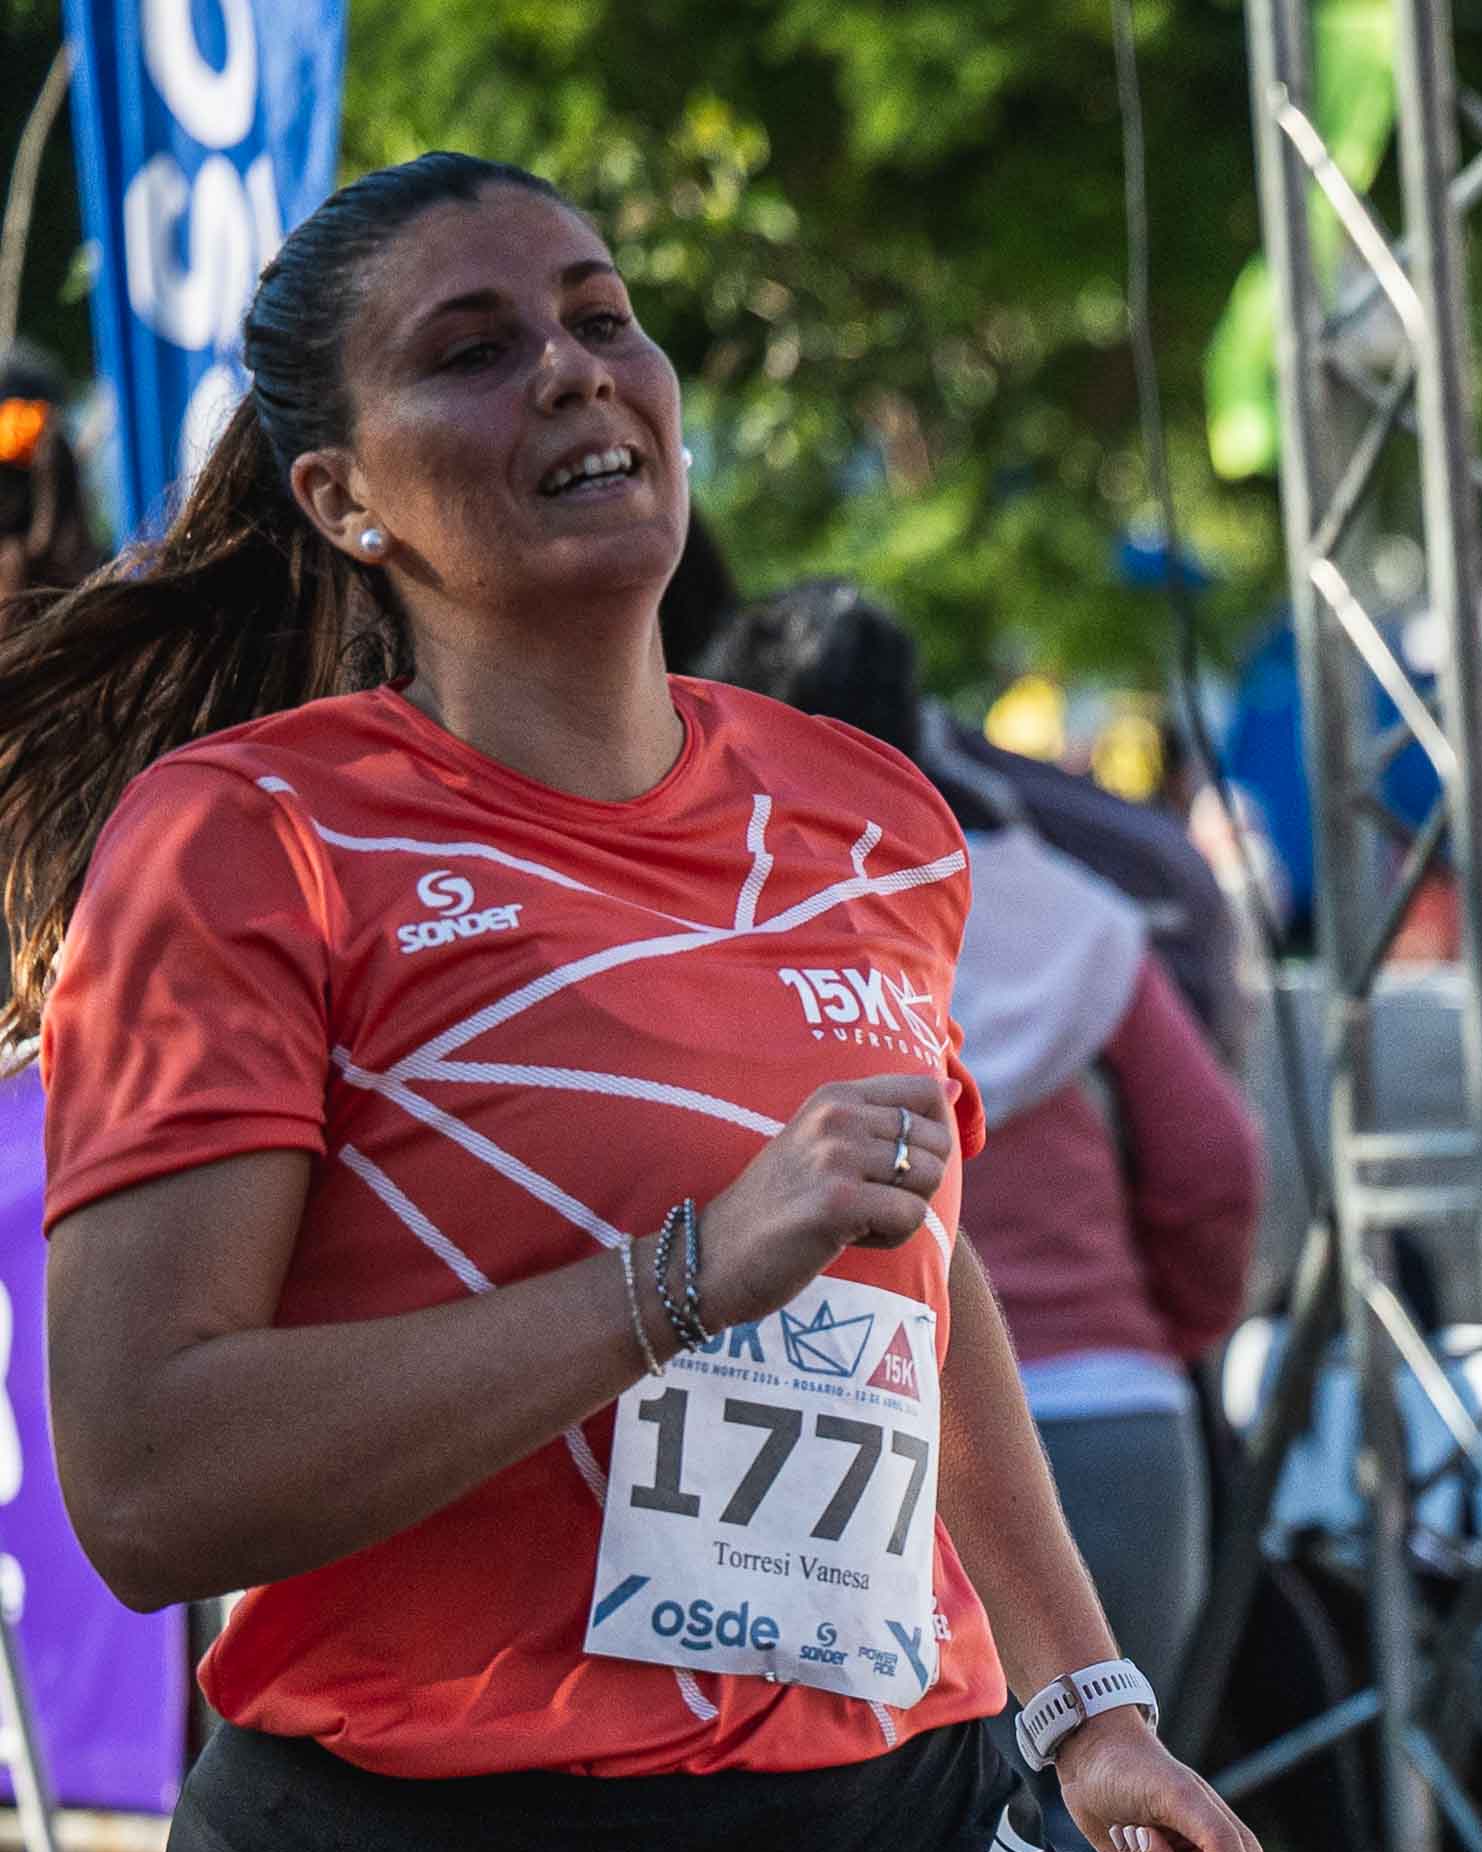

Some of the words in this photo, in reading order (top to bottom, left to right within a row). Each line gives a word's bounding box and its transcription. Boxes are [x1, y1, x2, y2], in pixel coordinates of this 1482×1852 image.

[778, 967, 900, 1031] 15K
[671, 1357, 709, 1375] UERTO
[883, 1352, 915, 1388] 15K
[630, 1386, 930, 1557] 1777
[713, 1541, 790, 1577] Torresi
[799, 1555, 870, 1590] Vanesa
[651, 1599, 781, 1650] osde
